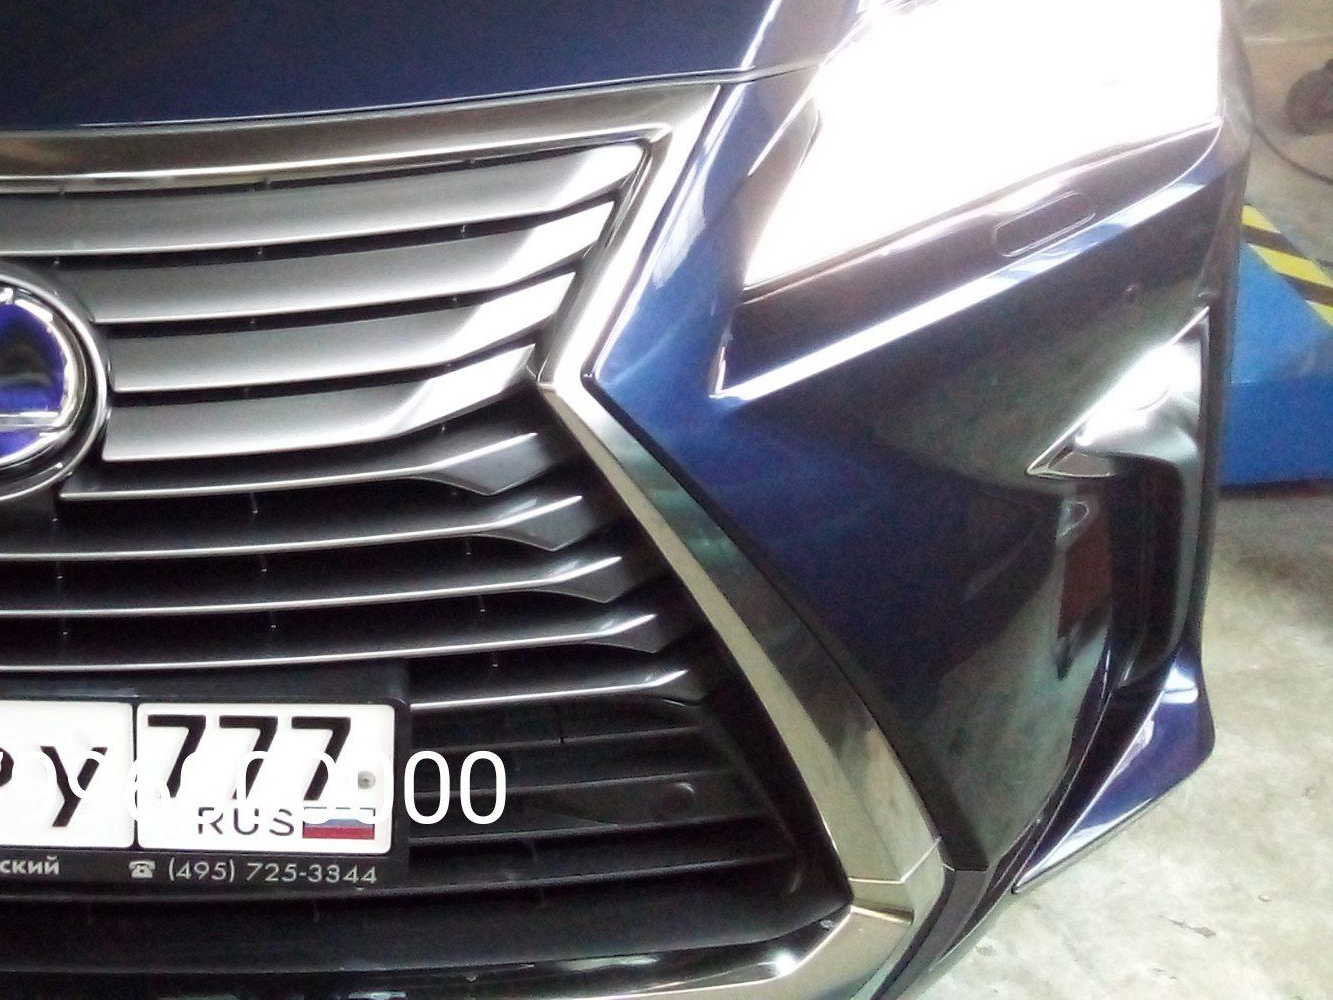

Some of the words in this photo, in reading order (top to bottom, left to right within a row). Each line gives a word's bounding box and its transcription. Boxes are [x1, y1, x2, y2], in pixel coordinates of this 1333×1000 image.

[147, 714, 352, 802] 777
[198, 807, 295, 837] RUS
[168, 857, 236, 884] (495)
[245, 862, 378, 885] 725-3344
